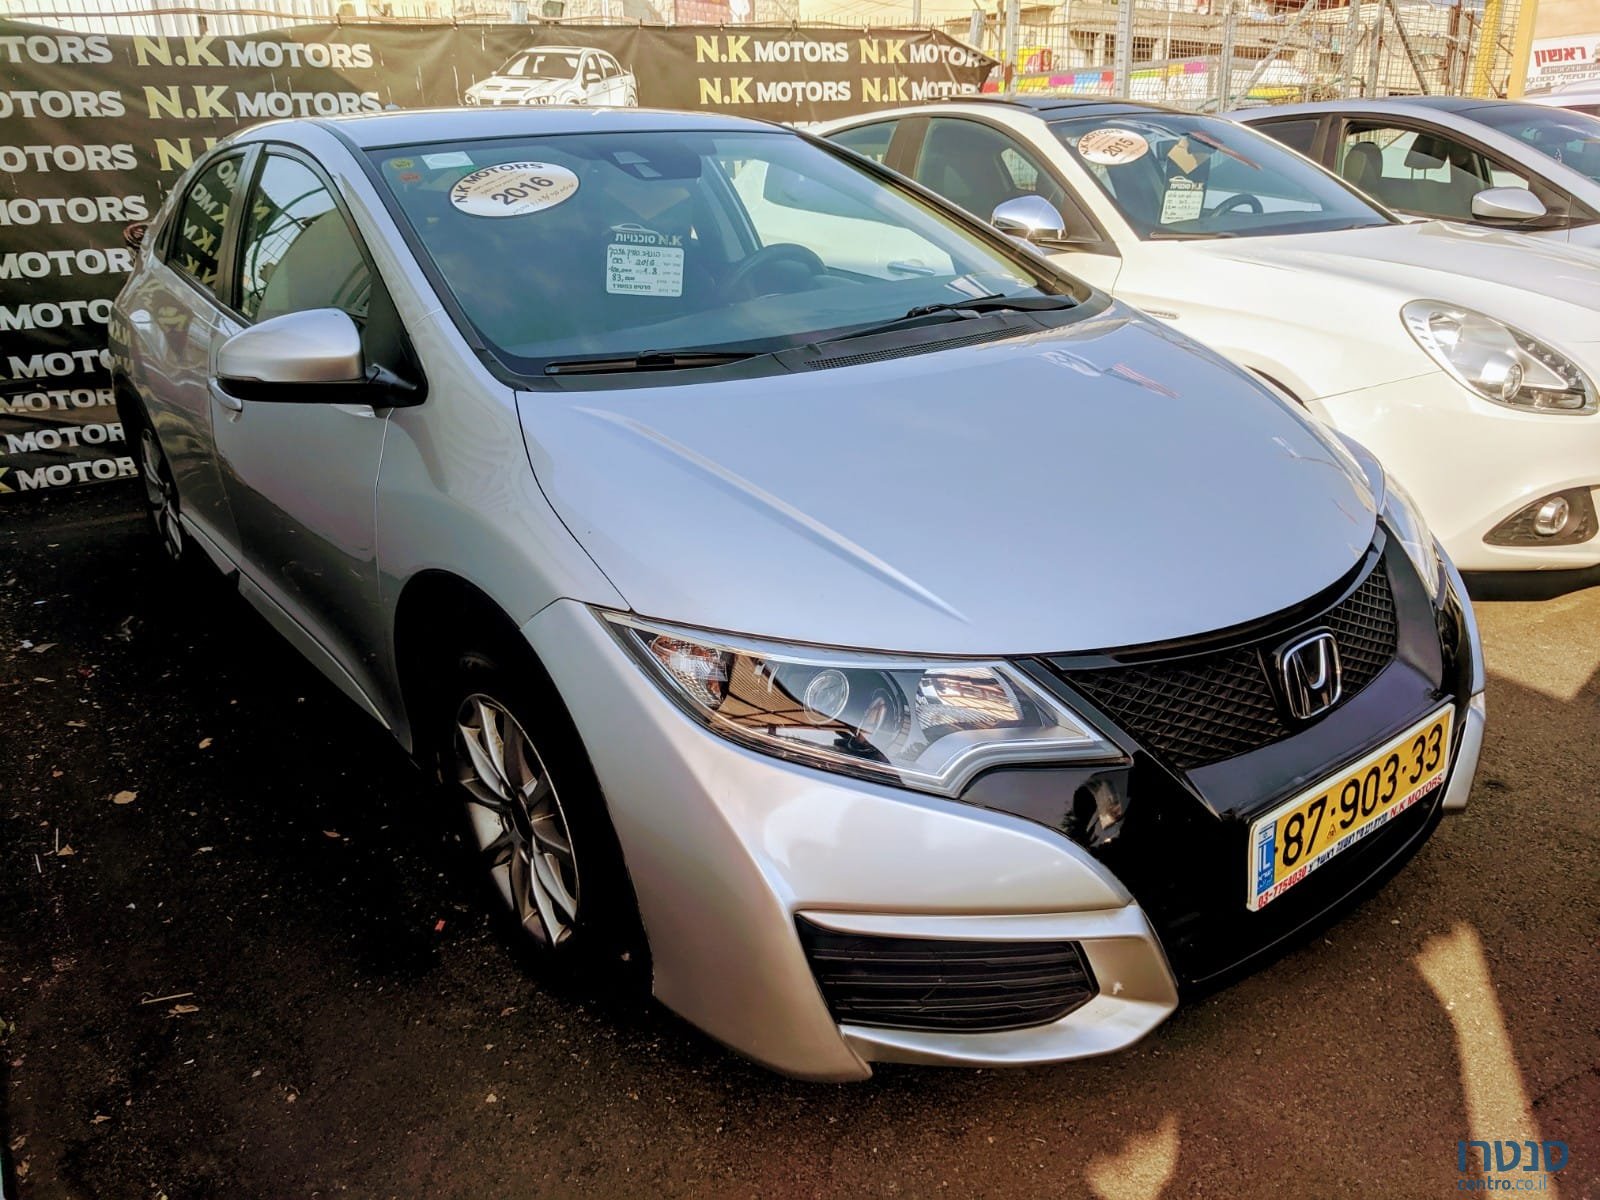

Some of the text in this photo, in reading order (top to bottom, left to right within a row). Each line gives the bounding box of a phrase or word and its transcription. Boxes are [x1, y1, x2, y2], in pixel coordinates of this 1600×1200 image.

[133, 35, 374, 68] N.K MOTORS
[695, 35, 849, 63] N.K MOTORS
[859, 39, 908, 64] N.K
[1534, 46, 1587, 67] ראשון
[142, 85, 381, 119] N.K MOTORS
[698, 77, 851, 104] N.K MOTORS
[861, 77, 910, 104] N.K
[1102, 137, 1134, 157] 2015
[454, 186, 471, 203] N.K
[467, 163, 545, 185] MOTORS
[491, 176, 554, 206] 2016
[615, 233, 683, 246] N.K סוכנויות
[1407, 773, 1443, 806] MOTORS
